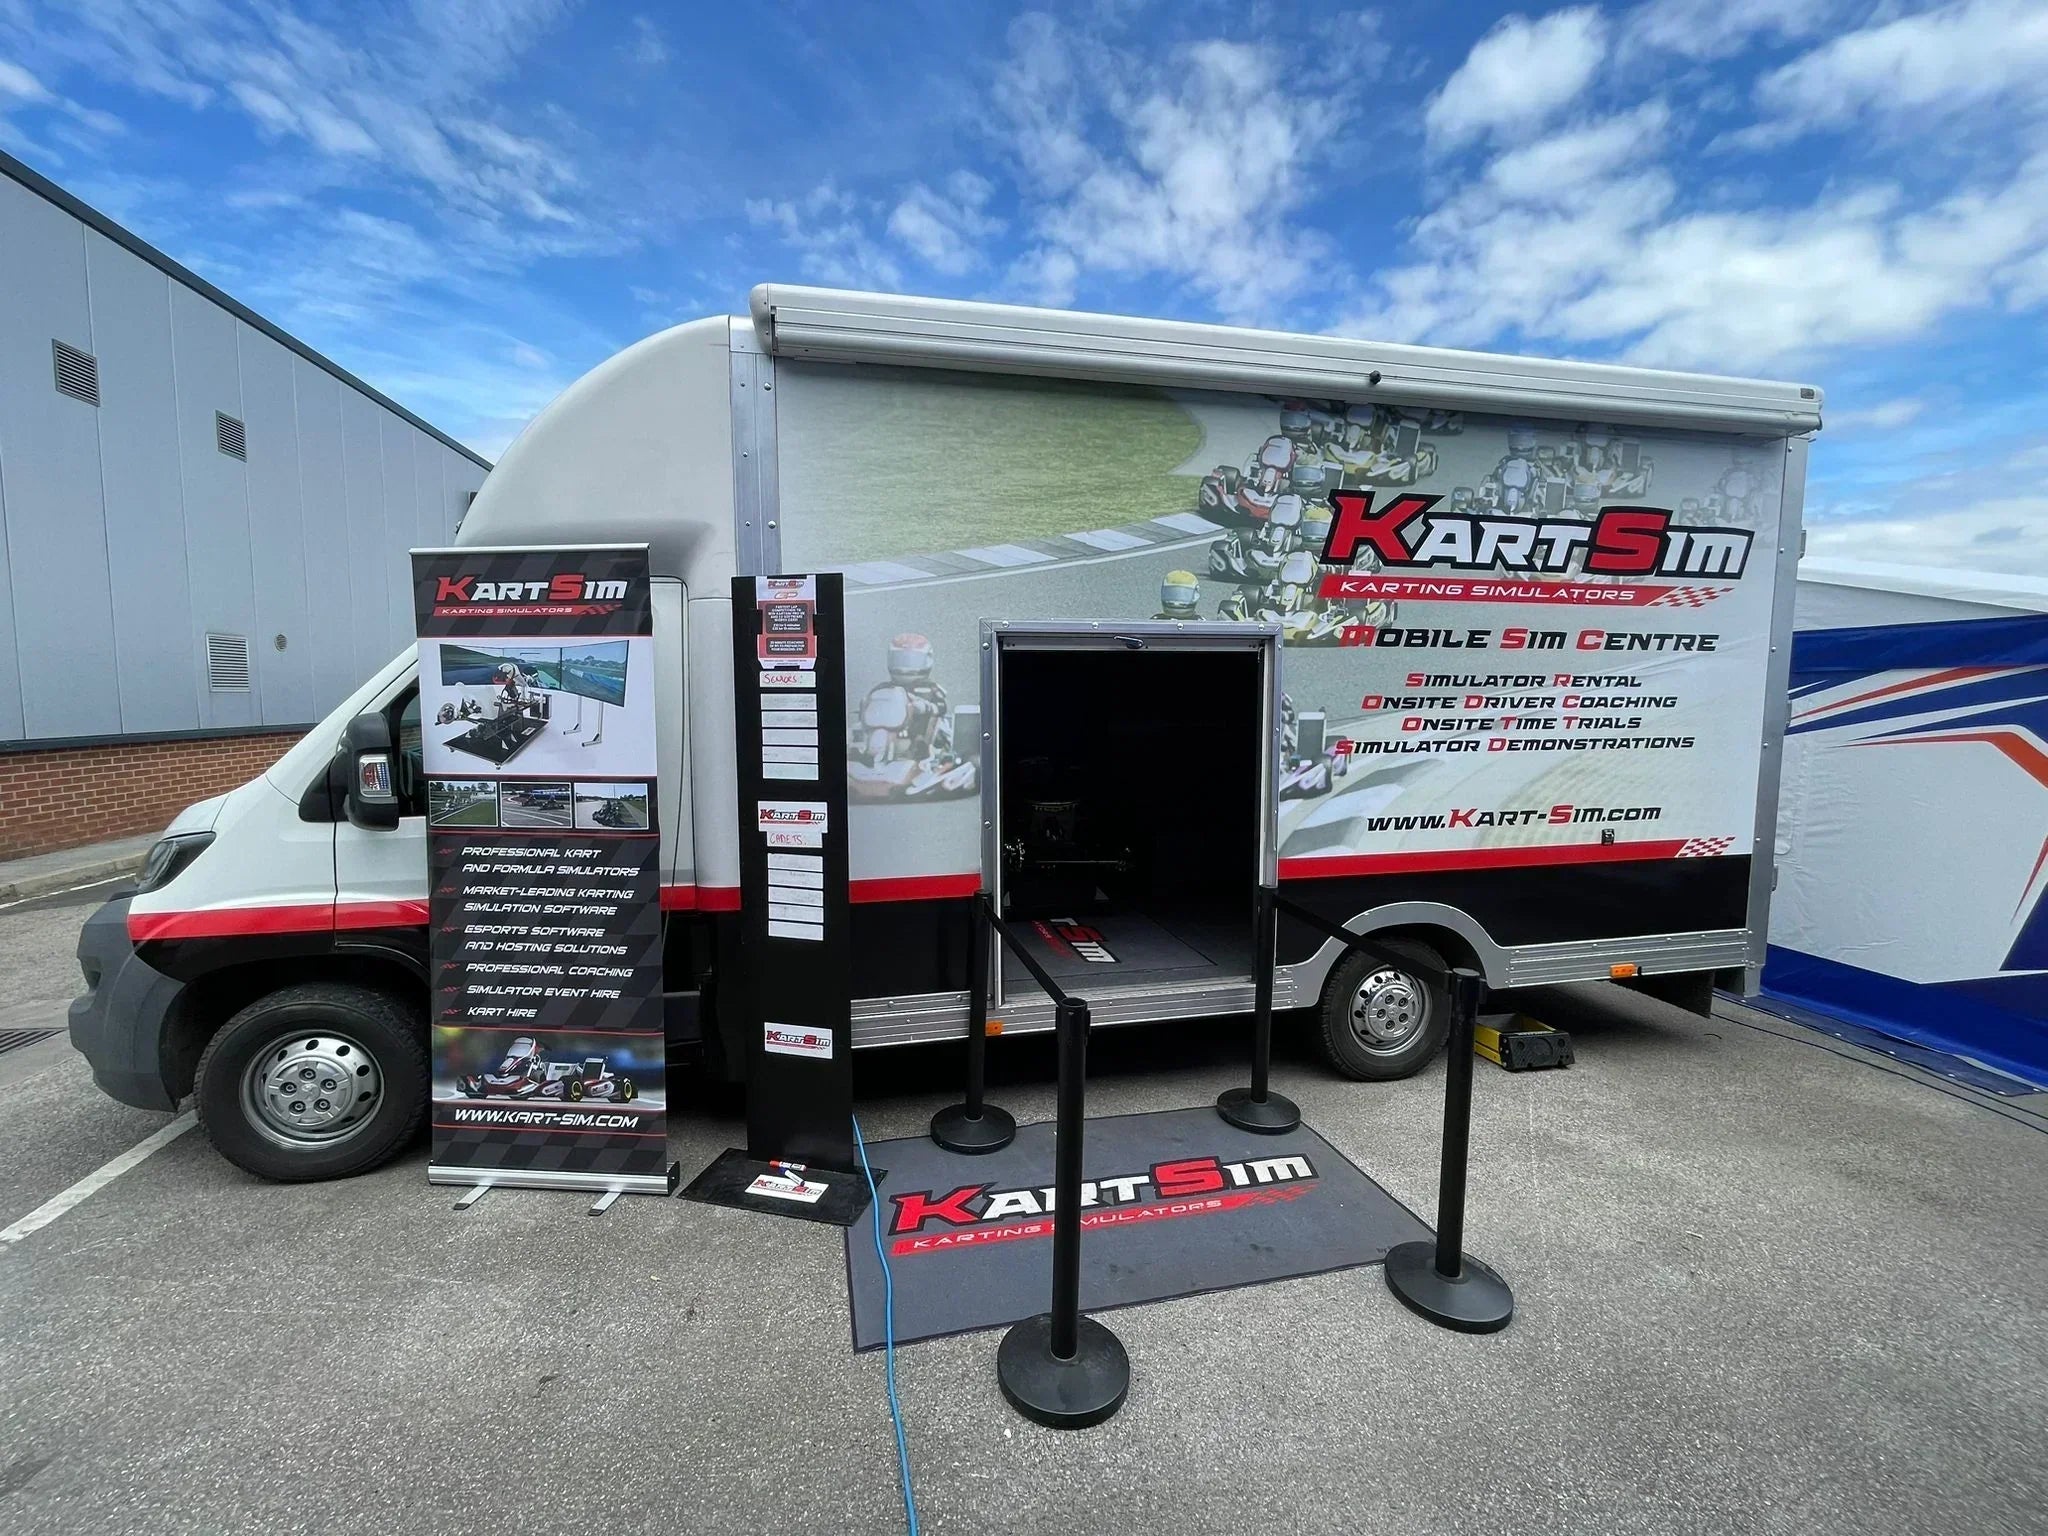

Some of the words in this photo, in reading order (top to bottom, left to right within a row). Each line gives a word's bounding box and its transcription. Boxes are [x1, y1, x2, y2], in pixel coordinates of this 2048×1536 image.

[1340, 581, 1462, 595] KARTING
[1470, 585, 1635, 600] SIMULATORS
[1339, 625, 1491, 649] MOBILE
[1500, 628, 1567, 650] SIM
[1576, 629, 1720, 652] CENTRE
[1405, 673, 1546, 688] SIMULATOR
[1552, 673, 1642, 688] RENTAL
[1361, 695, 1457, 710] ONSITE
[1463, 695, 1556, 709] DRIVER
[1561, 695, 1677, 709] COACHING
[1401, 716, 1495, 731] ONSITE
[1500, 716, 1557, 730] TIME
[1562, 716, 1642, 730] TRIALS
[1335, 738, 1479, 755] SIMULATOR
[1486, 736, 1695, 752] DEMONSTRATIONS
[462, 846, 562, 858] PROFESSIONAL
[564, 849, 601, 859] KART
[463, 863, 491, 873] AND
[492, 864, 554, 875] FORMULA
[556, 866, 640, 877] SIMULATORS
[463, 886, 575, 897] MARKET-LEADING
[577, 888, 634, 899] KARTING
[464, 903, 541, 914] SIMULATION
[543, 904, 617, 916] SOFTWARE
[464, 925, 528, 936] ESPORTS
[531, 926, 605, 937] SOFTWARE
[465, 941, 493, 950] AND
[496, 942, 551, 953] HOSTING
[554, 944, 627, 955] SOLUTIONS
[466, 963, 564, 975] PROFESSIONAL
[569, 966, 633, 977] COACHING
[467, 985, 542, 996] SIMULATOR
[544, 987, 589, 998] EVENT
[590, 988, 621, 999] HIRE
[467, 1007, 505, 1017] KART
[506, 1007, 537, 1018] HIRE
[454, 1108, 639, 1129] WWW.KART-SIM.COM
[912, 1224, 1042, 1249] KARTING
[1051, 1200, 1223, 1233] MULATORS
